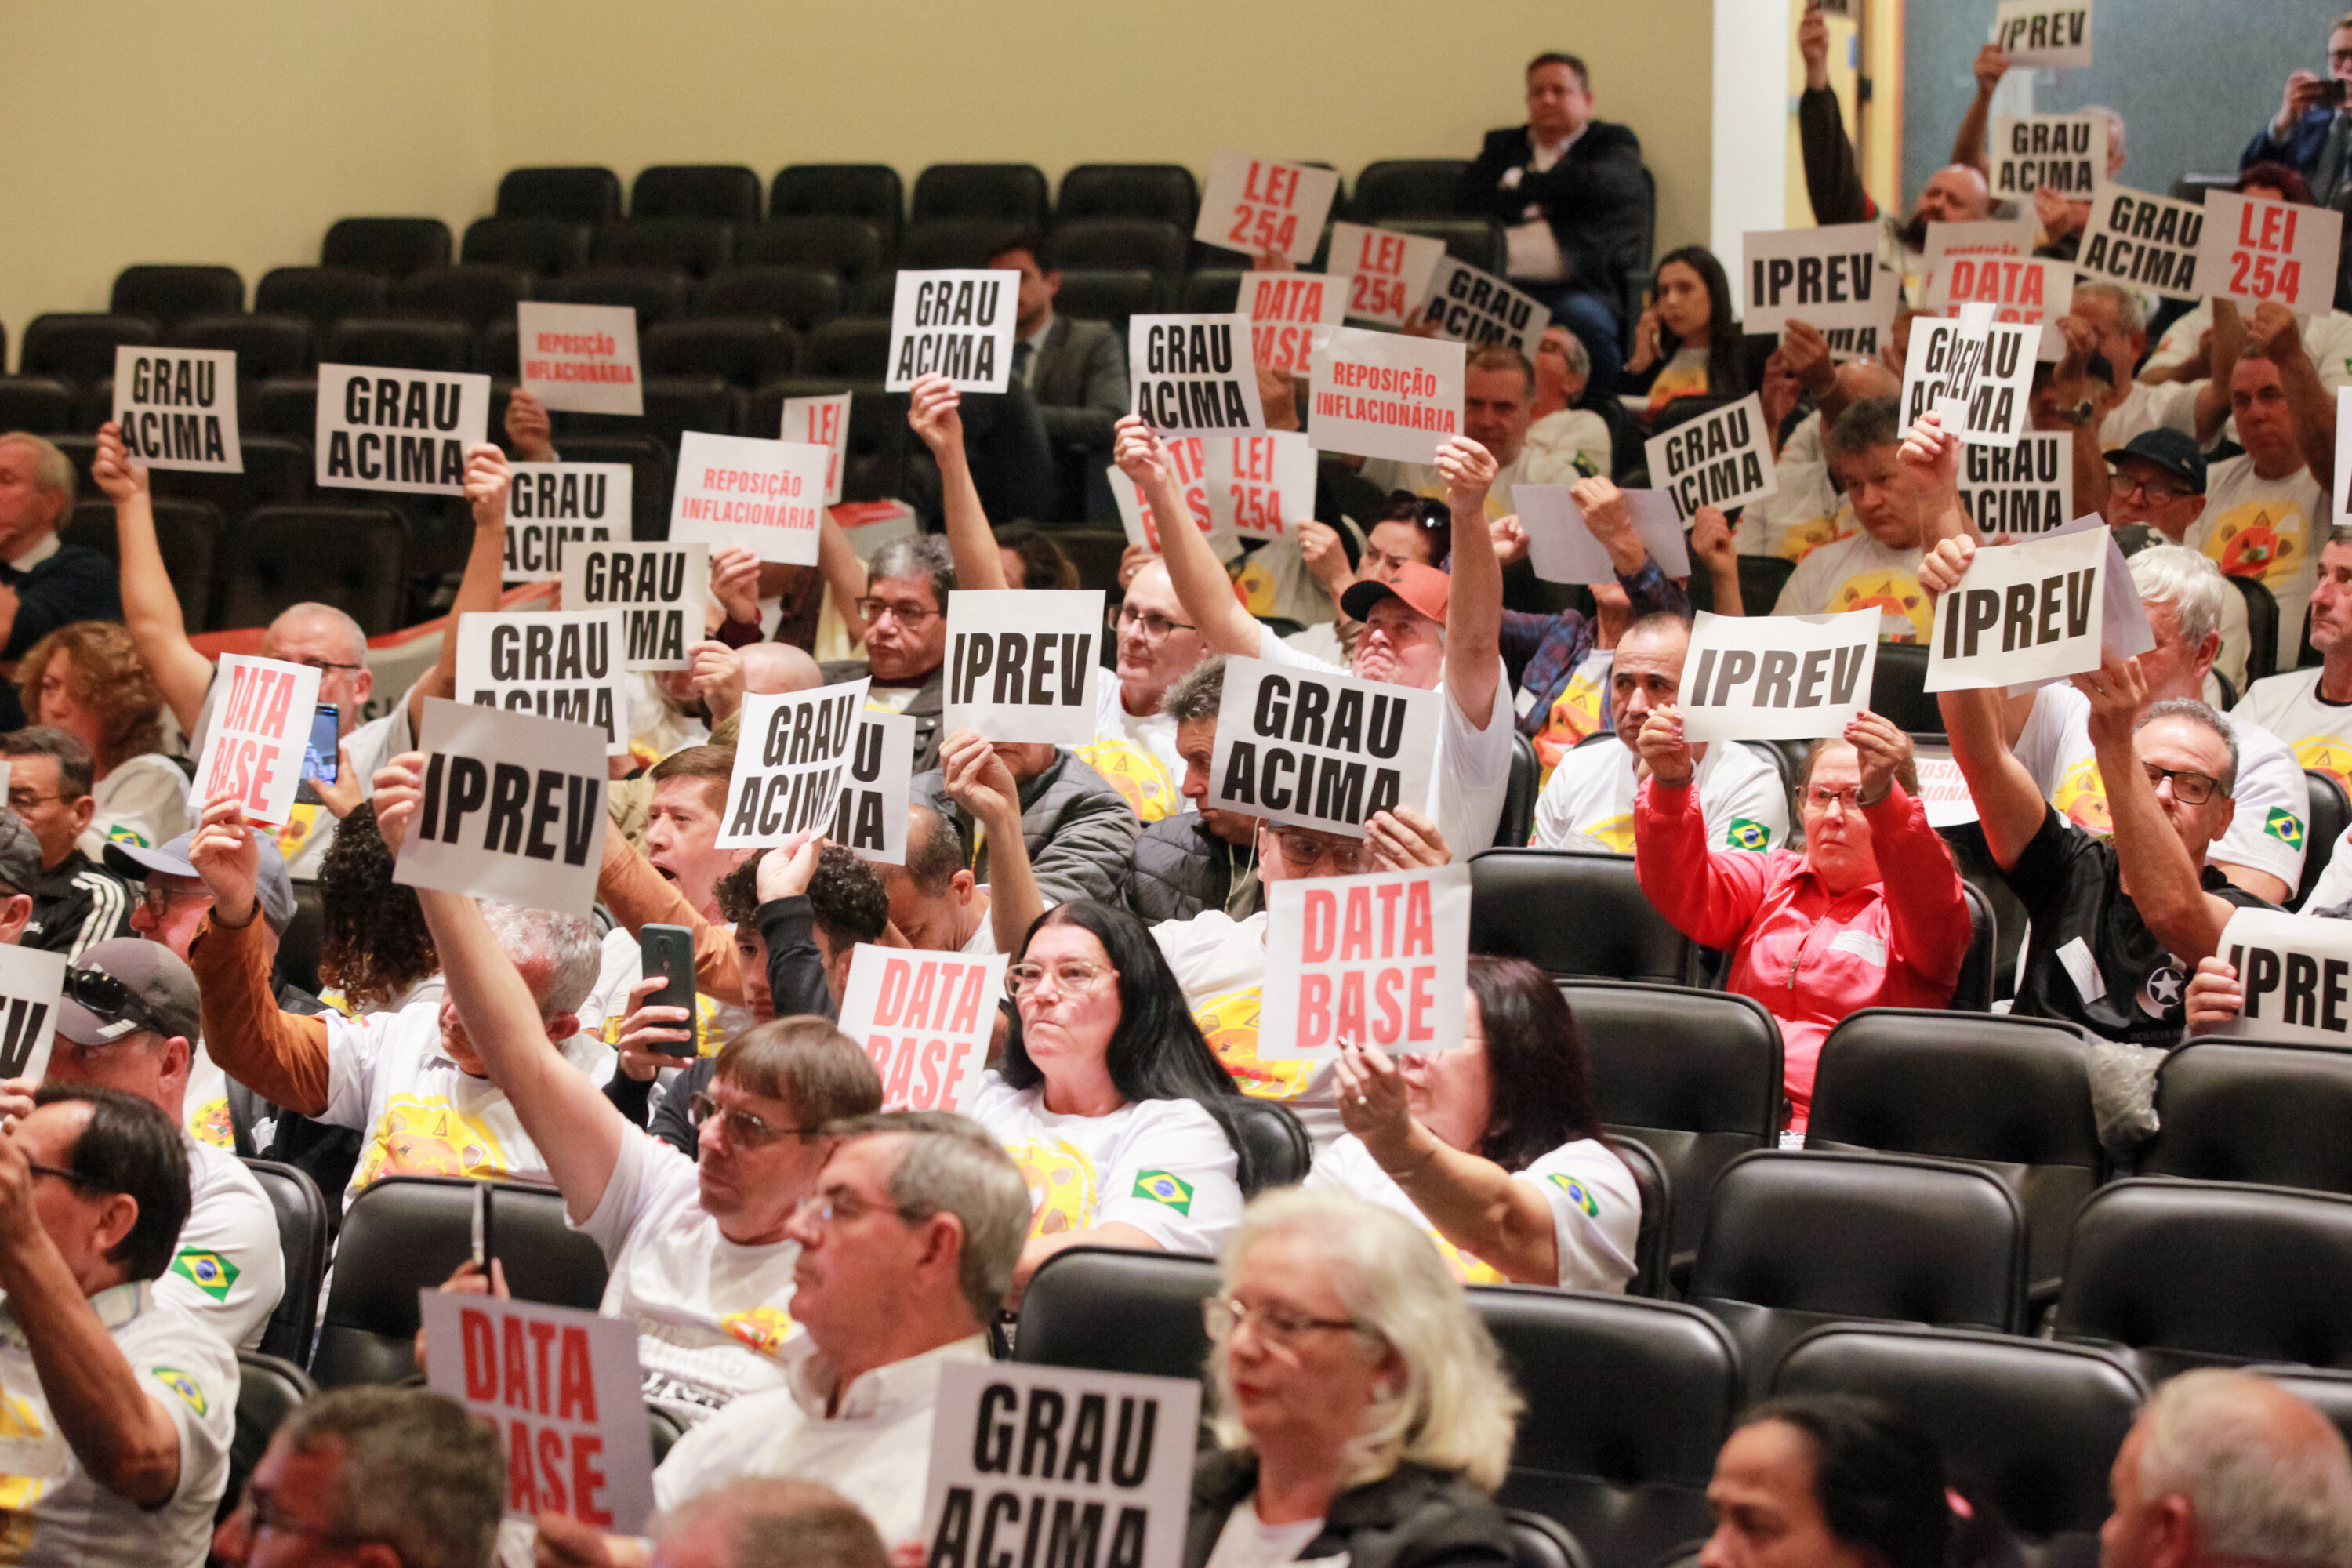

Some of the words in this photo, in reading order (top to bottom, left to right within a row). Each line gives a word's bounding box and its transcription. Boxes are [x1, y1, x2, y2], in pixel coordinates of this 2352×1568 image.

[1999, 10, 2085, 52] IPREV
[2012, 122, 2091, 156] GRAU
[1243, 160, 1301, 209] LEI
[1999, 159, 2092, 194] ACIMA
[1229, 204, 1298, 255] 254
[2108, 195, 2203, 248] GRAU
[2238, 202, 2298, 255] LEI
[1358, 234, 1406, 277] LEI
[1752, 252, 1874, 307] IPREV
[2085, 232, 2198, 292] ACIMA
[2229, 251, 2302, 303] 254
[915, 280, 1000, 327] GRAU
[1254, 279, 1324, 323] DATA
[1350, 274, 1406, 318] 254
[1447, 267, 1530, 332] GRAU
[1948, 260, 2044, 306] DATA
[895, 334, 995, 382] ACIMA
[1147, 324, 1233, 375] GRAU
[132, 357, 216, 408] GRAU
[345, 376, 461, 430] GRAU
[1138, 380, 1250, 430] ACIMA
[1333, 361, 1436, 401] REPOSIÇÃO
[121, 412, 226, 463] ACIMA
[808, 403, 841, 448] LEI
[1316, 392, 1456, 434] INFLACIONÁRIA
[328, 430, 463, 486] ACIMA
[1232, 436, 1274, 482] LEI
[1666, 405, 1750, 477] GRAU
[1966, 440, 2057, 483] GRAU
[511, 472, 607, 519] GRAU
[703, 468, 803, 499] REPOSIÇÃO
[1229, 485, 1284, 535] 254
[681, 496, 815, 530] INFLACIONÁRIA
[583, 551, 686, 603] GRAU
[1942, 567, 2096, 661] IPREV
[491, 622, 608, 681] GRAU
[949, 632, 1091, 706] IPREV
[1690, 643, 1867, 710] IPREV
[223, 665, 296, 739] DATA
[1253, 673, 1408, 759] GRAU
[762, 692, 856, 768] GRAU
[205, 735, 280, 812] BASE
[728, 763, 844, 837] ACIMA
[1221, 741, 1401, 826] ACIMA
[419, 753, 599, 867] IPREV
[1301, 880, 1434, 964] DATA
[872, 958, 987, 1034] DATA
[1295, 966, 1436, 1048] BASE
[866, 1034, 971, 1114] BASE
[461, 1308, 599, 1424] DATA
[972, 1383, 1159, 1489] GRAU
[506, 1416, 614, 1526] ASE
[931, 1486, 1151, 1568] ACIMA
